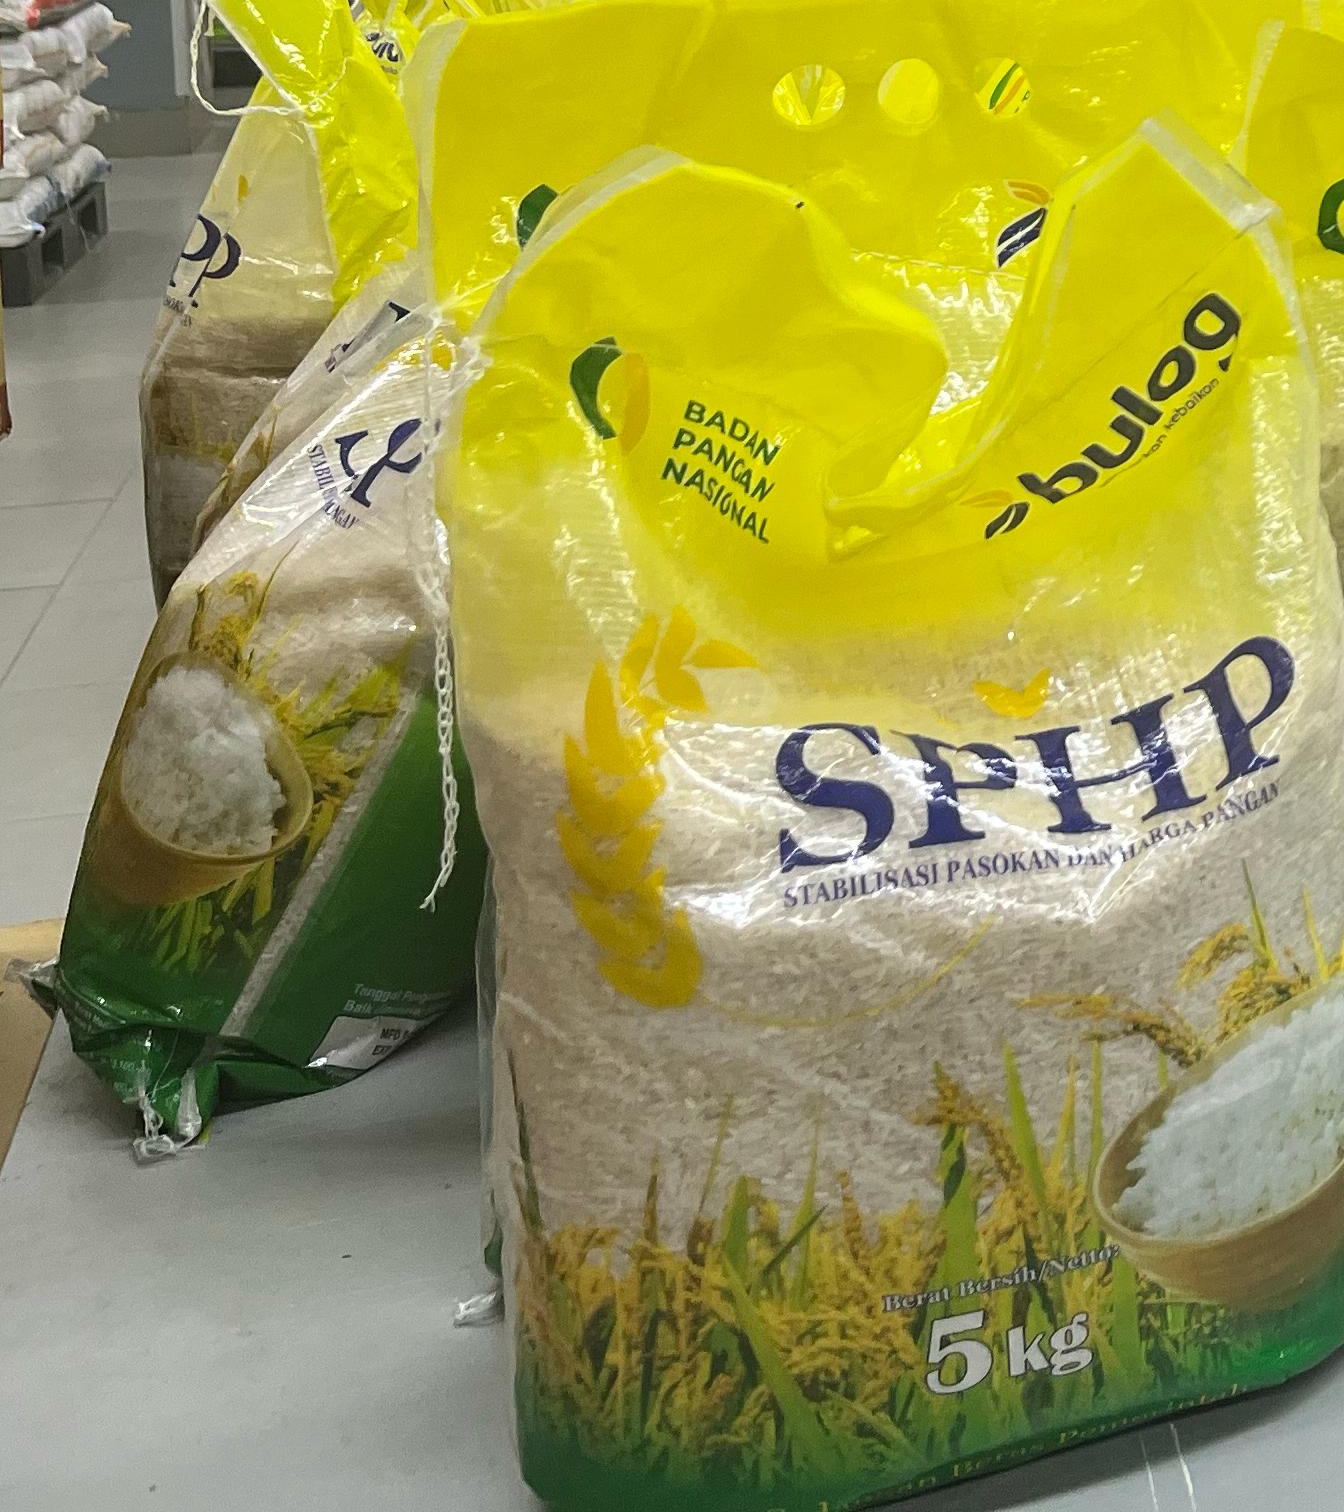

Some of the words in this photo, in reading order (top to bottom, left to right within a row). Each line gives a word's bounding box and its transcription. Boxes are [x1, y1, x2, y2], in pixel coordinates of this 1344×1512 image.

[683, 398, 780, 466] BADAN
[1018, 291, 1243, 505] bulog
[1164, 377, 1220, 430] kebaikan
[661, 456, 771, 544] NASIONAL
[671, 428, 777, 503] PANGAN
[775, 635, 1297, 874] SPHP
[782, 866, 941, 908] STABILISASI
[946, 849, 1061, 885] PASOKAN
[1065, 843, 1115, 869] DAN
[1119, 817, 1197, 862] HARGA
[1201, 782, 1282, 832] PANGAN
[881, 1287, 951, 1314] Berat
[924, 1309, 994, 1395] 5
[1005, 1311, 1095, 1378] kg
